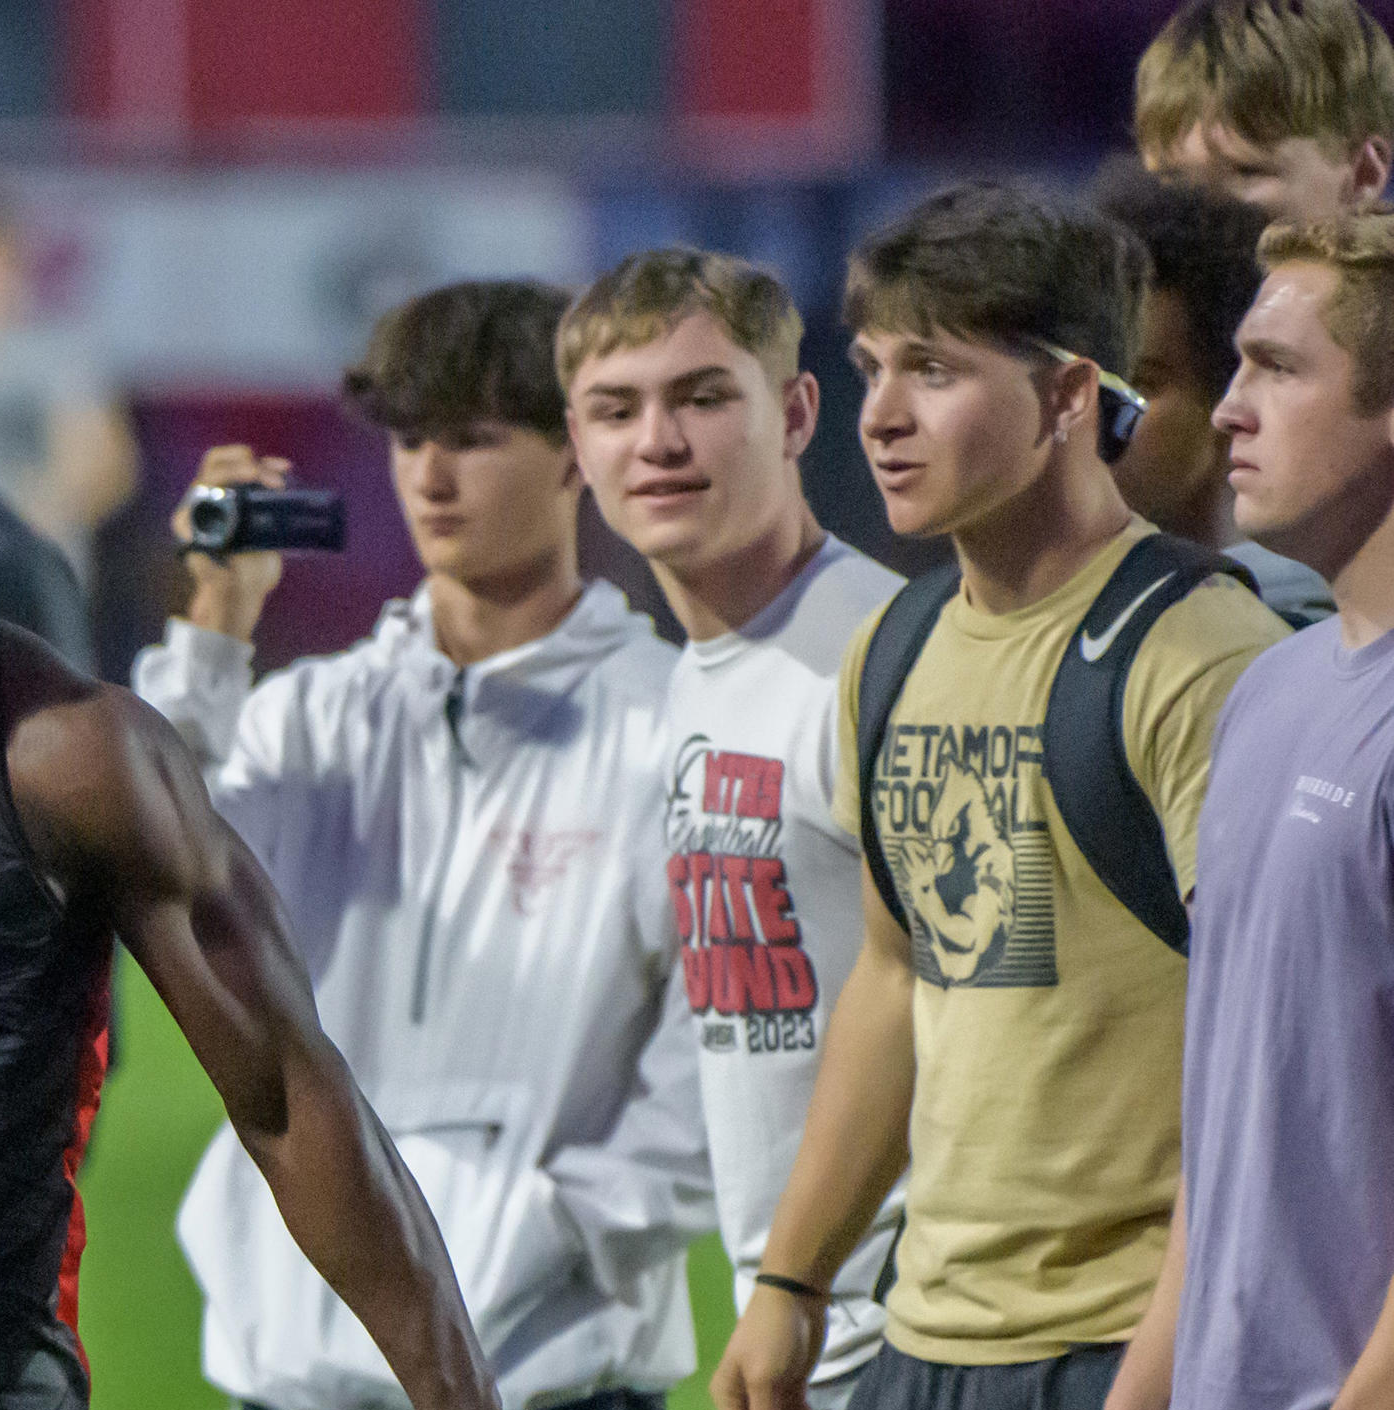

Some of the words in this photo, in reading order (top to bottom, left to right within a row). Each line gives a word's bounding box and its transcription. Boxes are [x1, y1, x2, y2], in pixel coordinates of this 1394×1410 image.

[666, 852, 803, 948] STATE
[681, 944, 819, 1014] OUND
[745, 1012, 815, 1053] 2023
